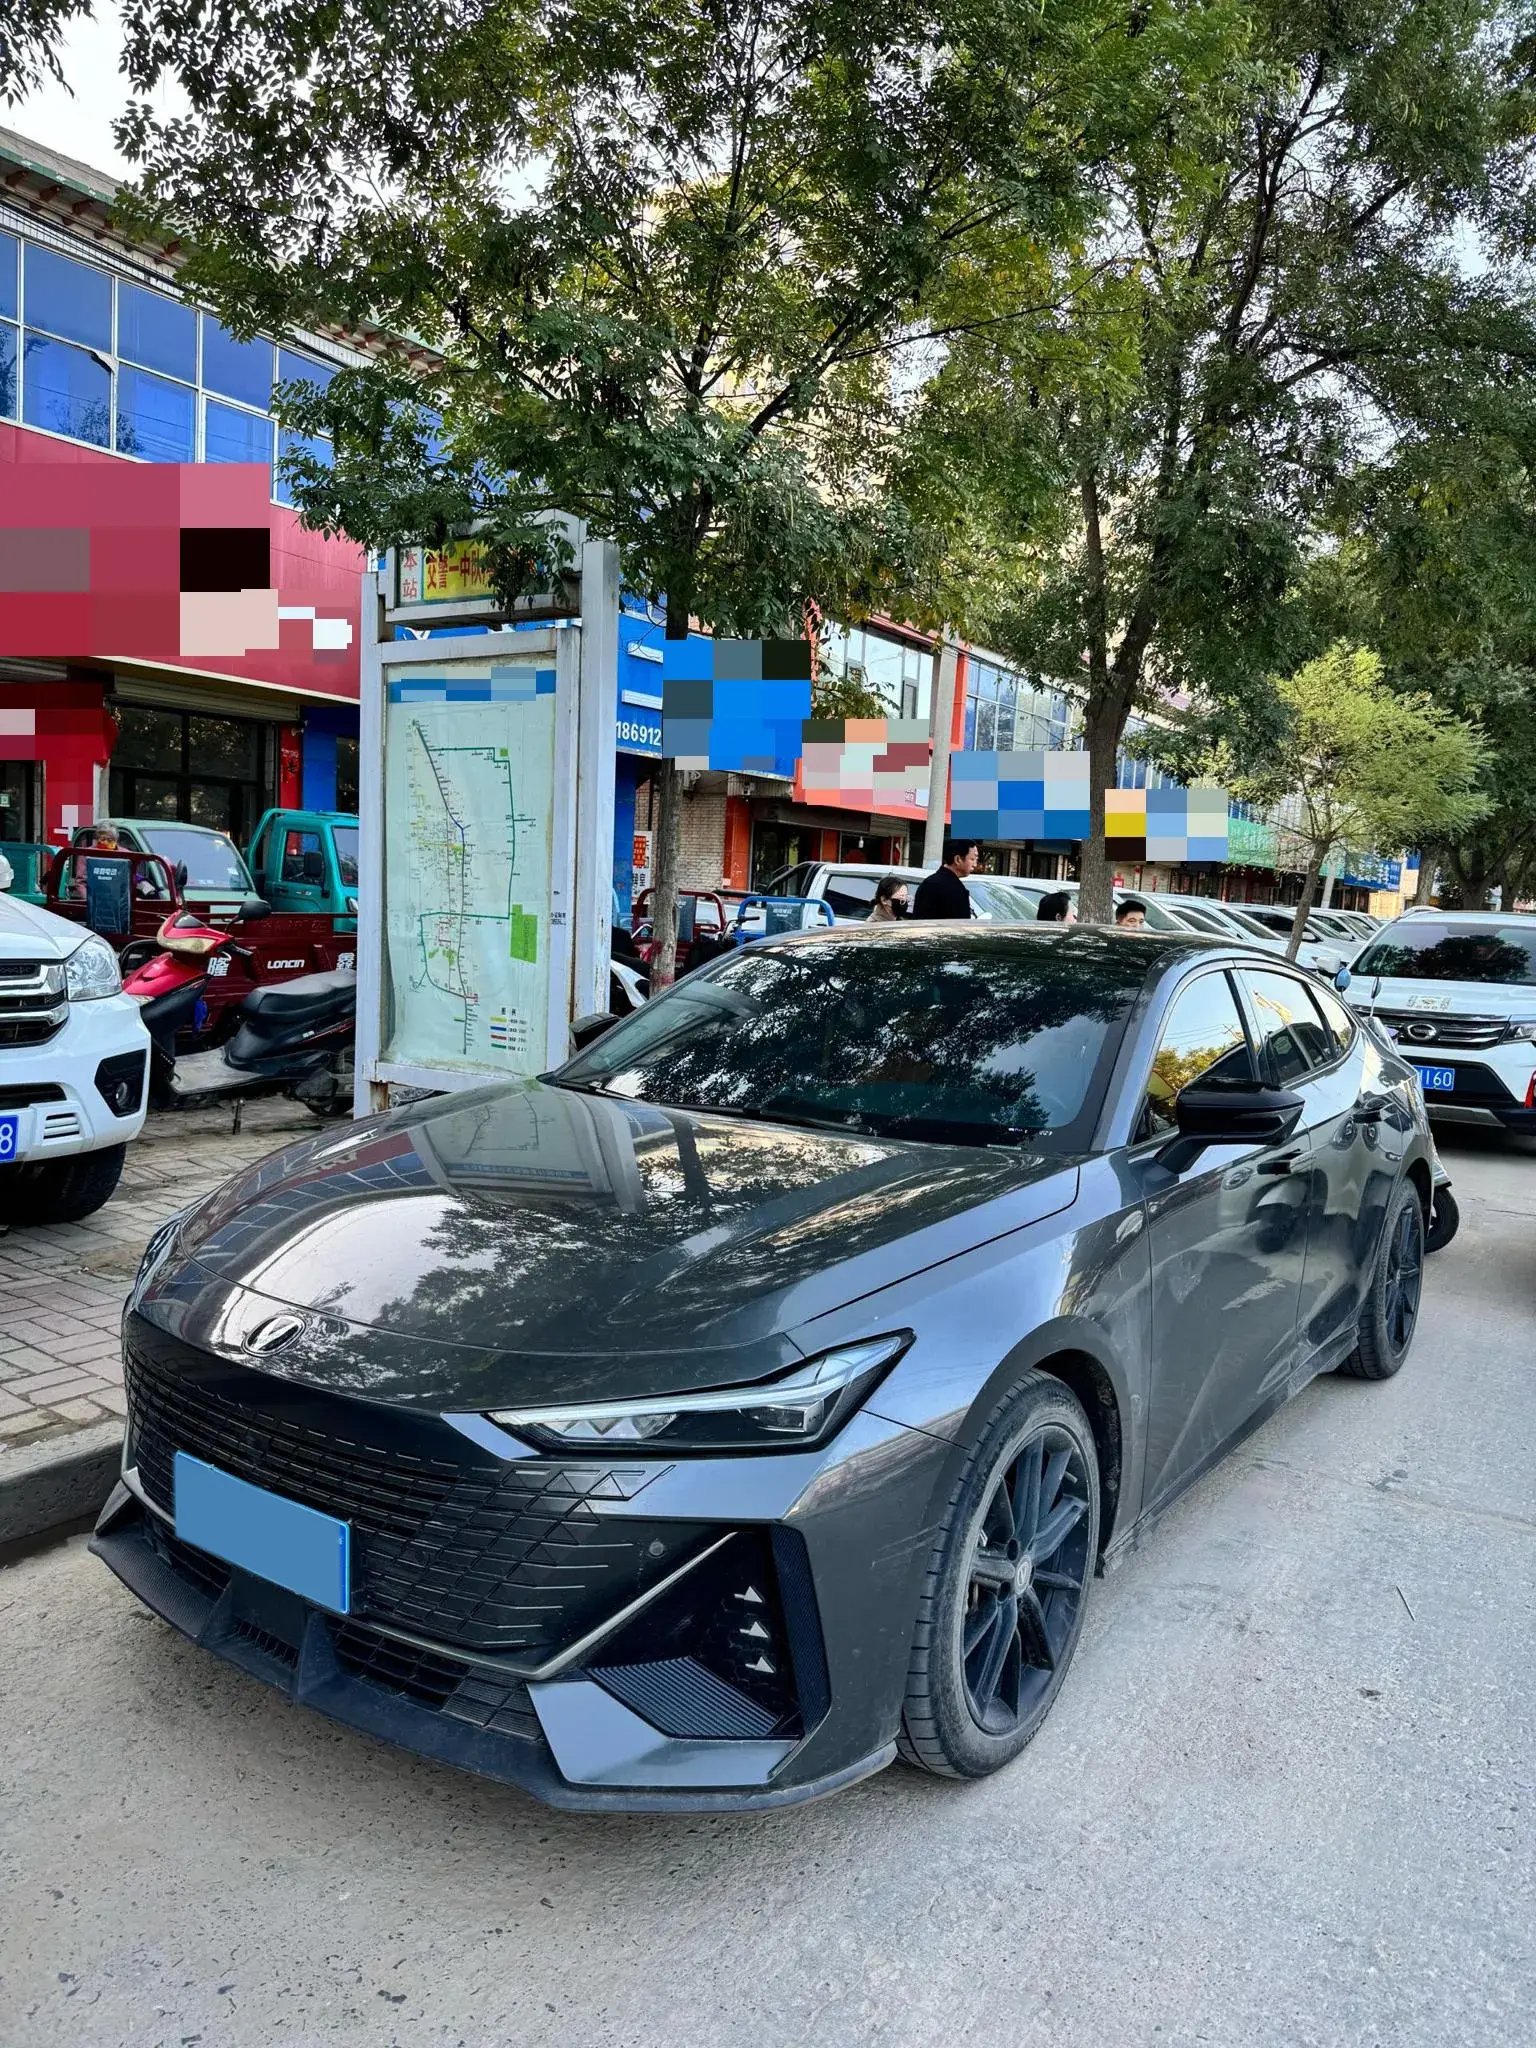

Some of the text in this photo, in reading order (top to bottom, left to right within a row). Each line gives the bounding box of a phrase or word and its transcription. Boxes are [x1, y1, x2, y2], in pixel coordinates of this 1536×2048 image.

[402, 550, 418, 599] 本站
[427, 549, 496, 591] 交警一中队
[616, 721, 662, 746] 186912
[267, 959, 305, 969] LONCIN
[1421, 1069, 1452, 1087] 160
